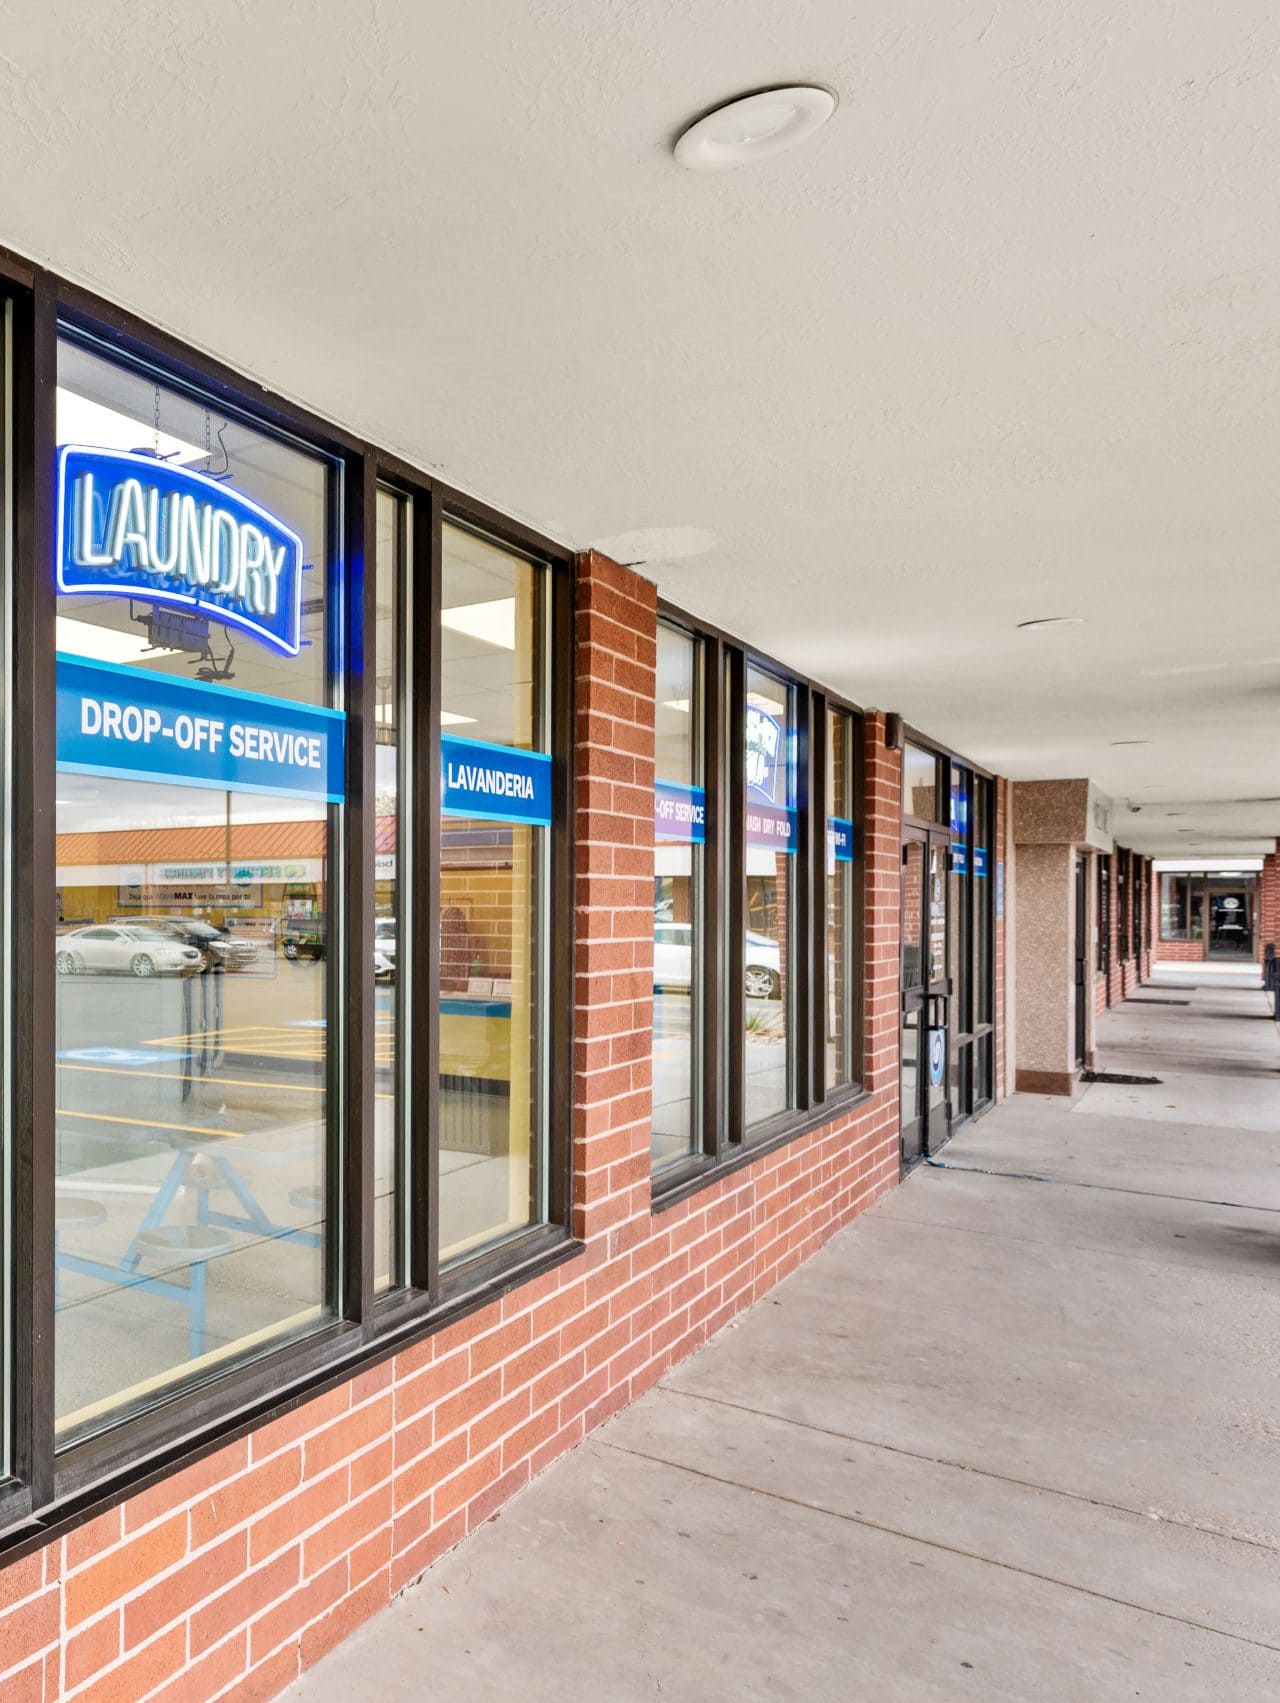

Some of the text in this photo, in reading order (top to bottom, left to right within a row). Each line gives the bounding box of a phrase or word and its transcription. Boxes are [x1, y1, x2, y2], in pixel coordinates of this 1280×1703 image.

[77, 472, 286, 615] LAUNDRY
[80, 697, 321, 768] DROP-OFF SERVICE
[448, 762, 535, 800] LAVANDERIA
[655, 800, 705, 824] -OFF SERVICE
[776, 820, 791, 837] FOLD
